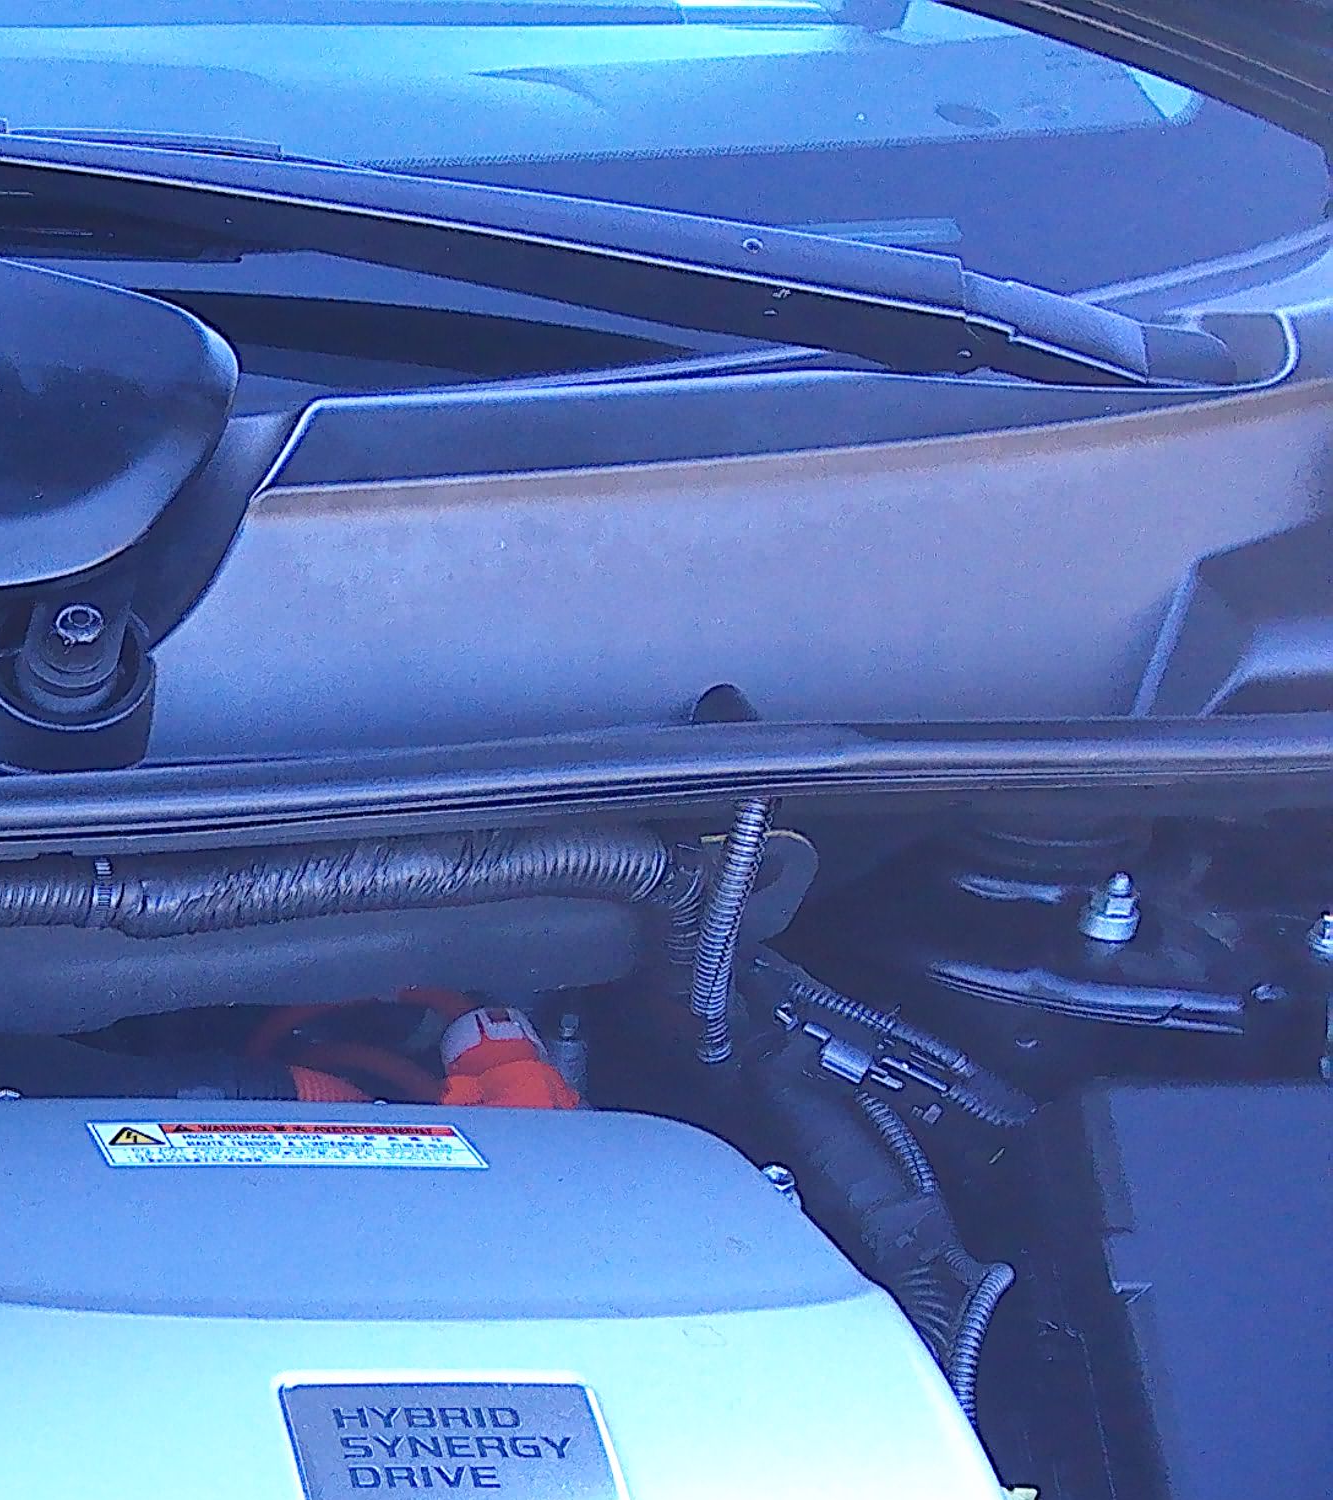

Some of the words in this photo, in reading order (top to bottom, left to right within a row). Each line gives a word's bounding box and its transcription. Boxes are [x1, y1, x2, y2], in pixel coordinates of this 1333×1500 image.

[332, 1407, 522, 1428] HYBRID
[339, 1436, 572, 1458] SYNERGY
[347, 1466, 502, 1489] DRIVE
